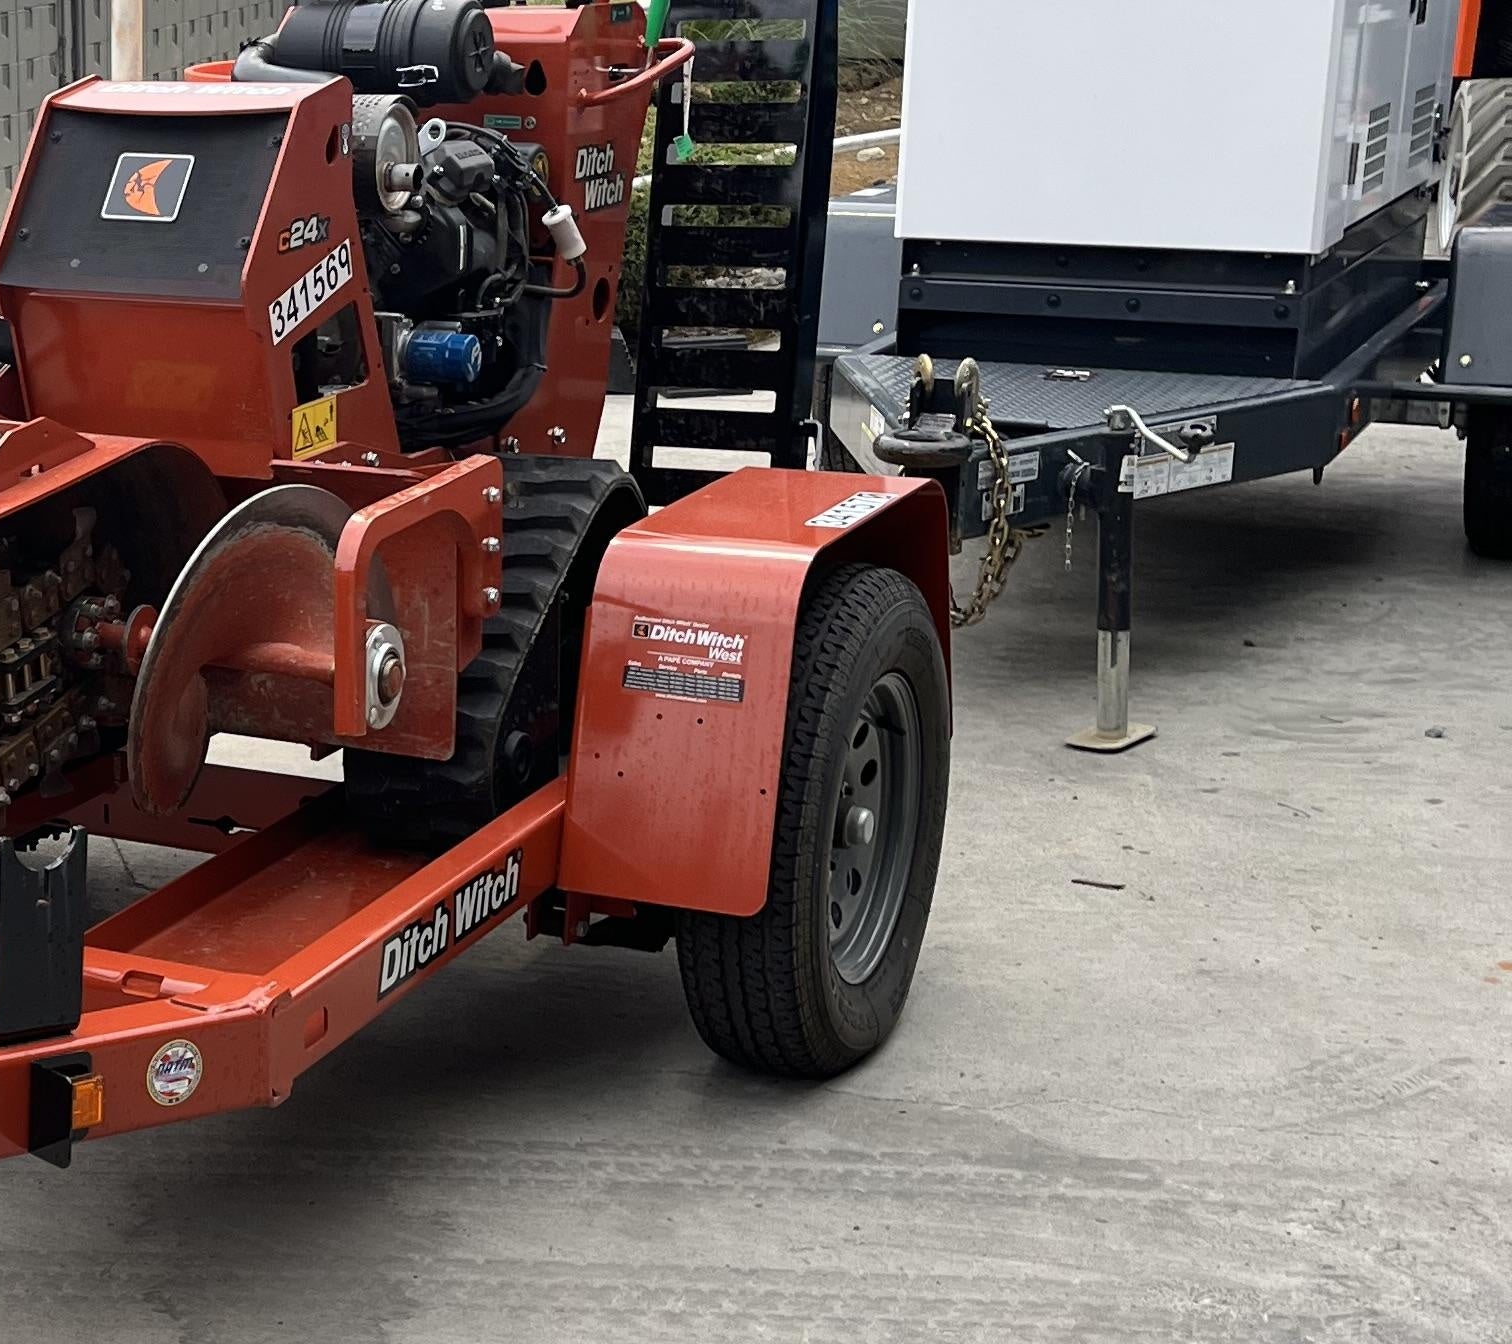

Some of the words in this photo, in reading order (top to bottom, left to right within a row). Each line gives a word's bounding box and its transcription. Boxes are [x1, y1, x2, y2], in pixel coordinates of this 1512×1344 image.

[575, 143, 615, 179] Ditch
[585, 173, 624, 210] Witch
[271, 243, 352, 338] 341569
[650, 624, 697, 645] Ditch
[697, 629, 745, 650] Witch
[708, 646, 743, 663] West
[380, 906, 449, 993] Ditch
[455, 856, 519, 938] Witch
